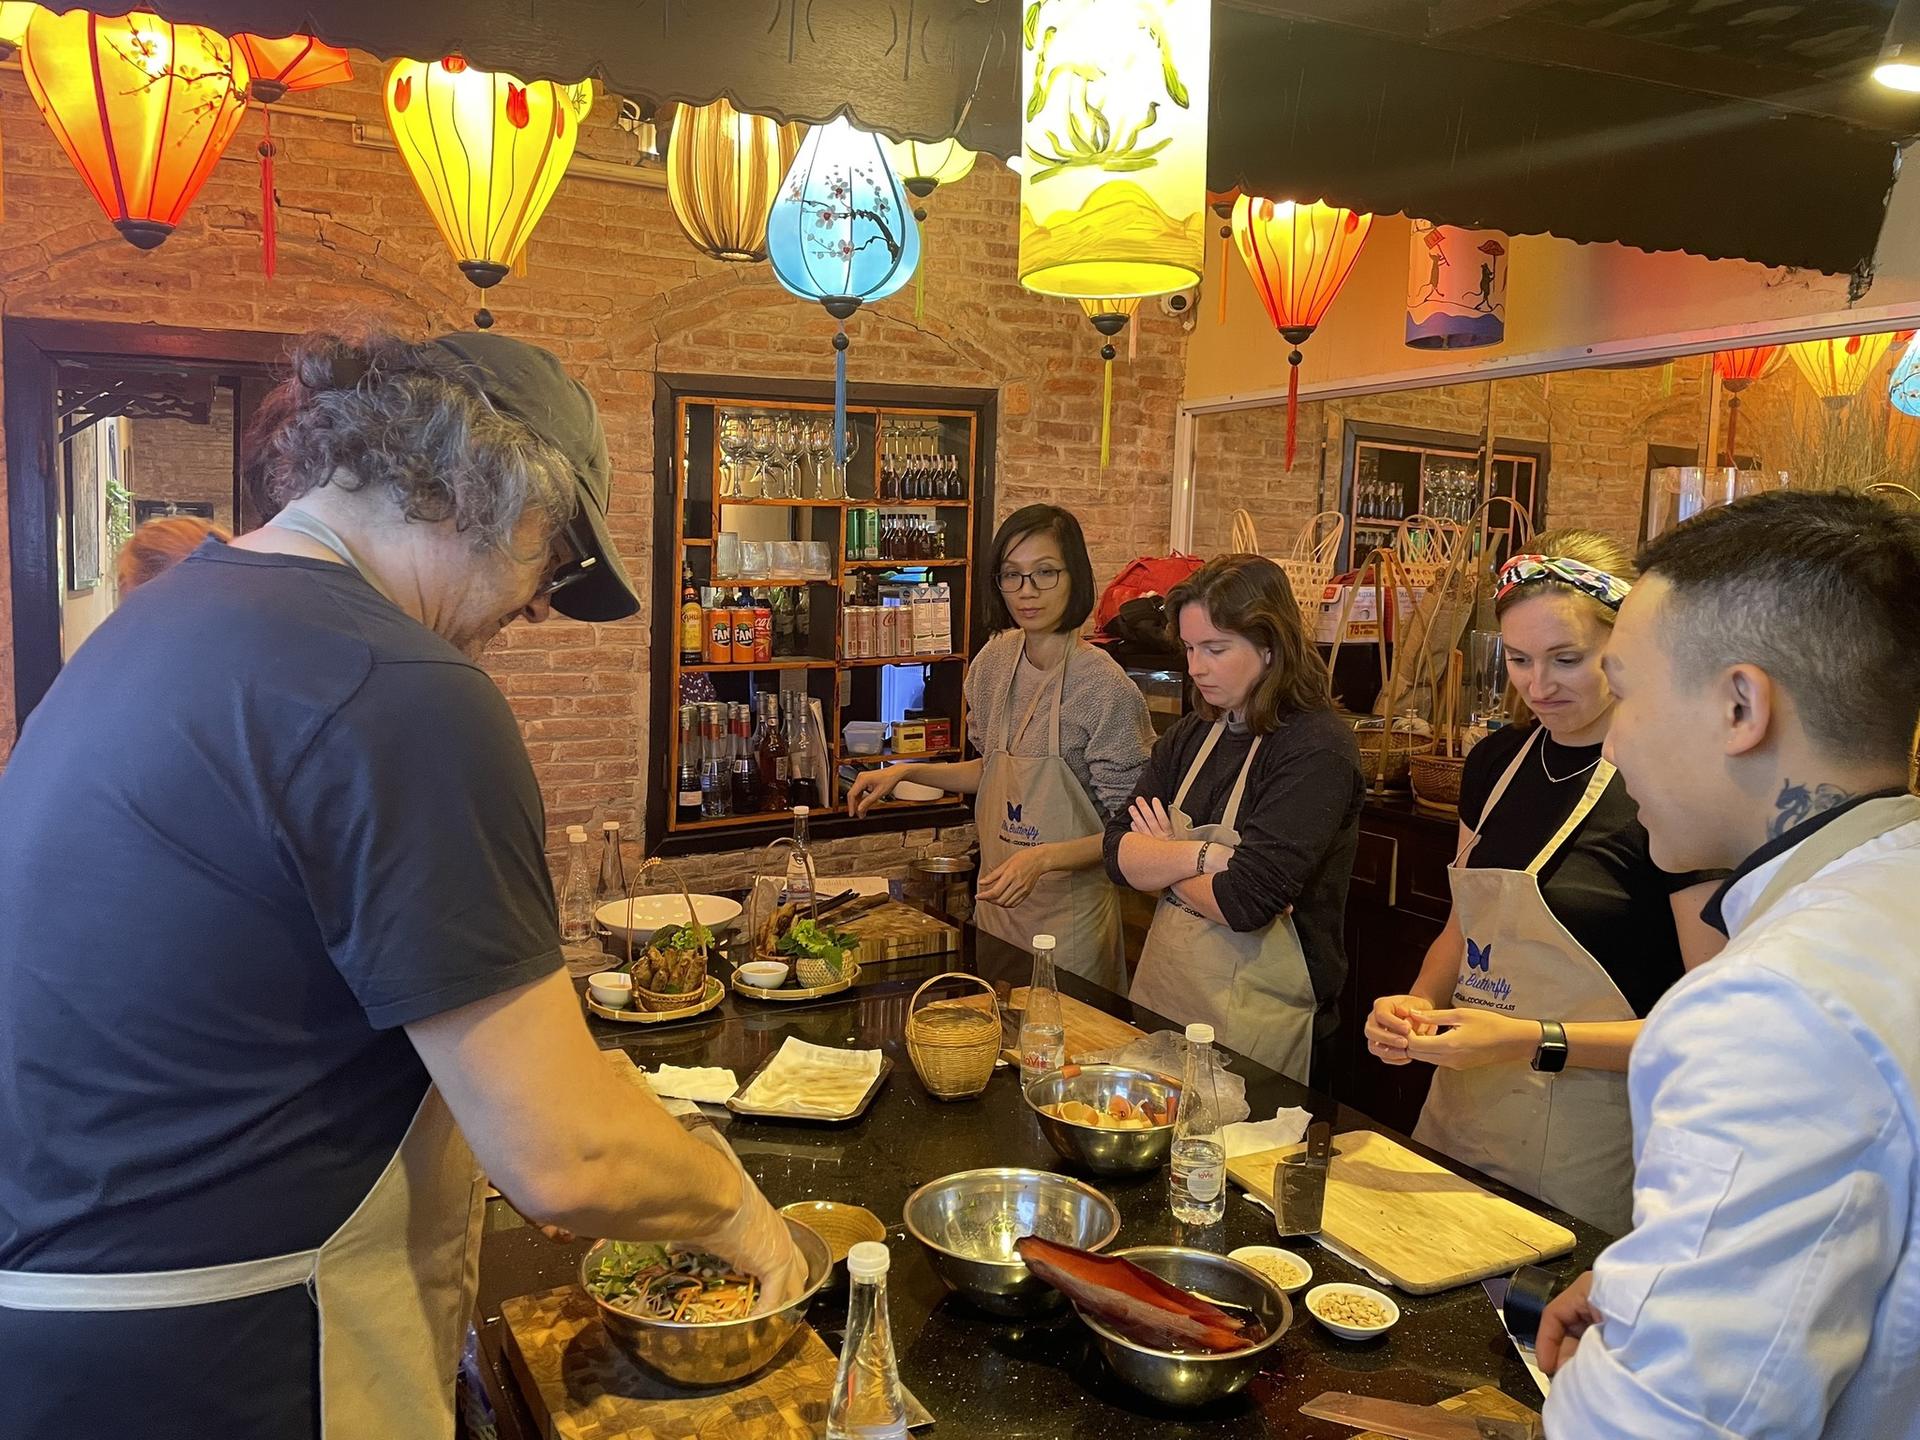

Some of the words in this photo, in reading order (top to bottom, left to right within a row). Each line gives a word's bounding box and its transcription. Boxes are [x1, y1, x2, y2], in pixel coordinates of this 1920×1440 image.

[1465, 973, 1512, 1001] Butterfly
[1467, 996, 1496, 1008] COOKING
[1495, 1003, 1516, 1012] CLASS
